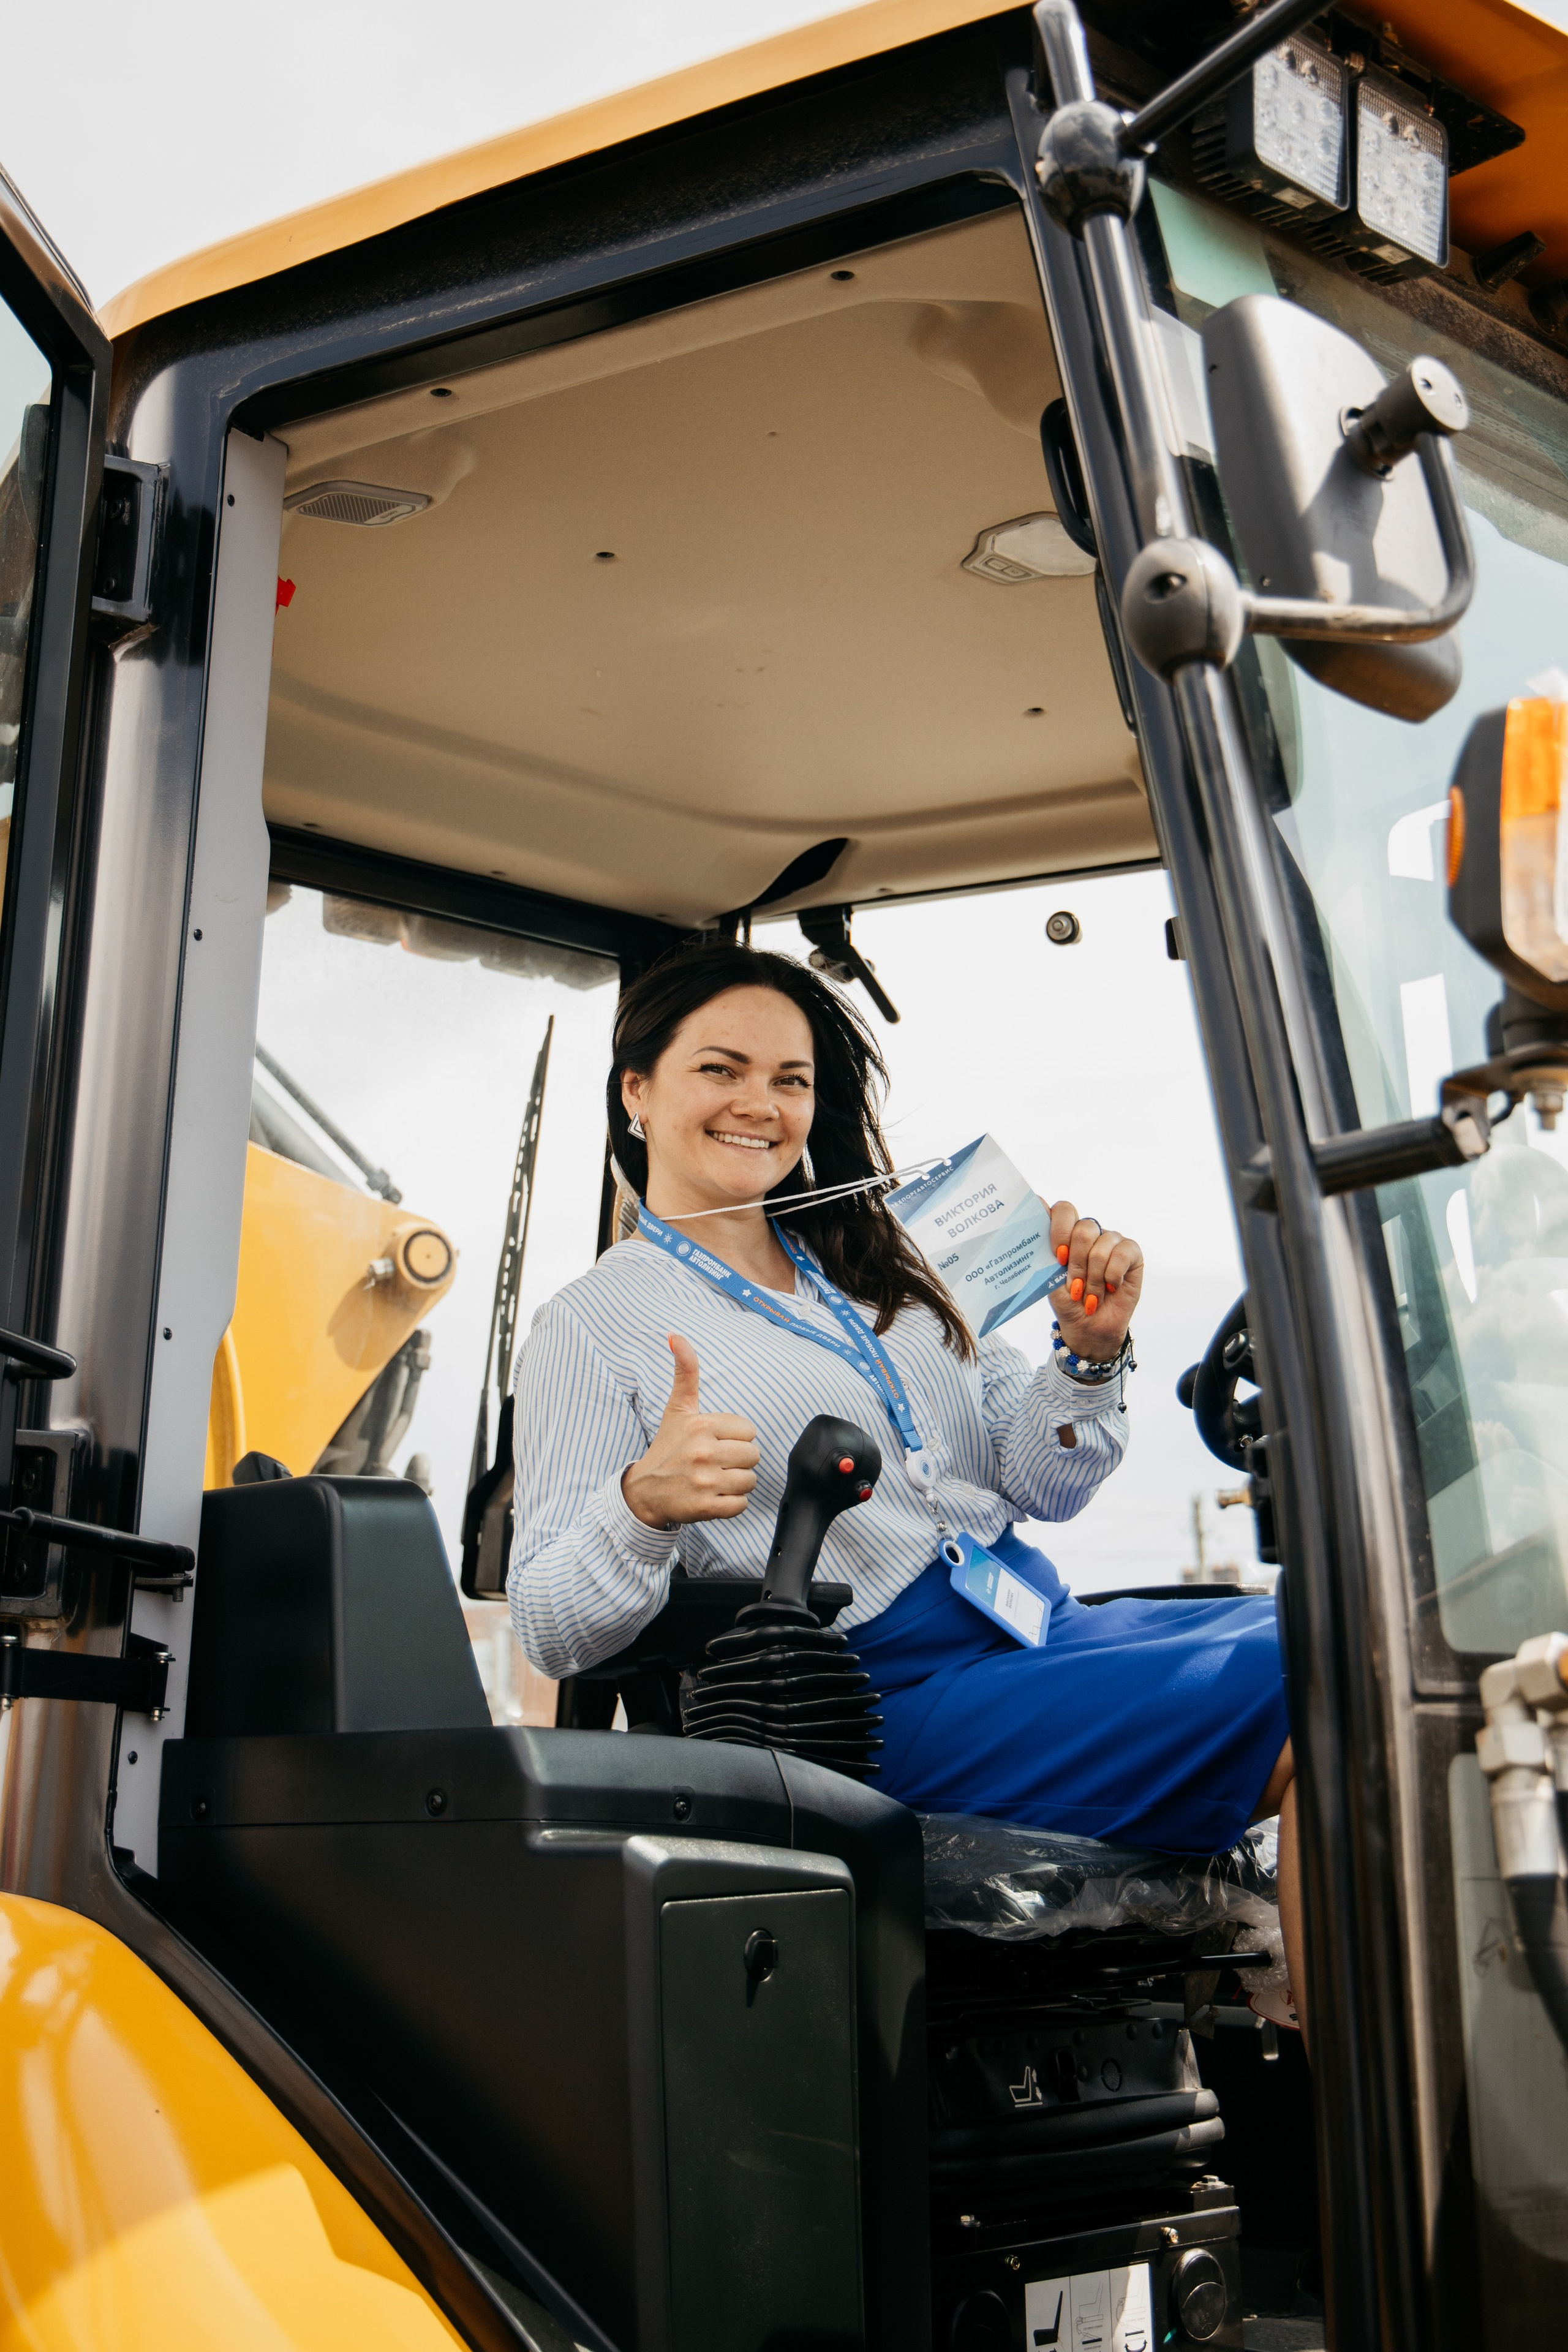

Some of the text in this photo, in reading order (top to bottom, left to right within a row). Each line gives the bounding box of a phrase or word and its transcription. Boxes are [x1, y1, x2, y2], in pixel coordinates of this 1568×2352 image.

[891, 1166, 954, 1208] ТЕХПОРТАВТОСЕРВИС
[934, 1183, 997, 1227] ВИКТОРИЯ
[646, 1222, 663, 1237] ДВЕРИ
[947, 1199, 1005, 1238] ВОЛКОВА
[688, 1256, 725, 1280] АВТОЛИЗИНГ
[692, 1248, 732, 1278] ГАЗПРОМБАНК
[937, 1253, 959, 1271] №05
[965, 1232, 1041, 1282] ООО «Газпромбанк
[984, 1251, 1034, 1285] Автолизинг»
[999, 1264, 1031, 1285] Челябинск
[753, 1297, 841, 1348] ОТКРЫВАЙ ЛЮБЫЕ ДВЕРИ
[847, 1318, 900, 1399] ОТКРЫВАЙ ЛЮБЫЕ ДВЕРИ
